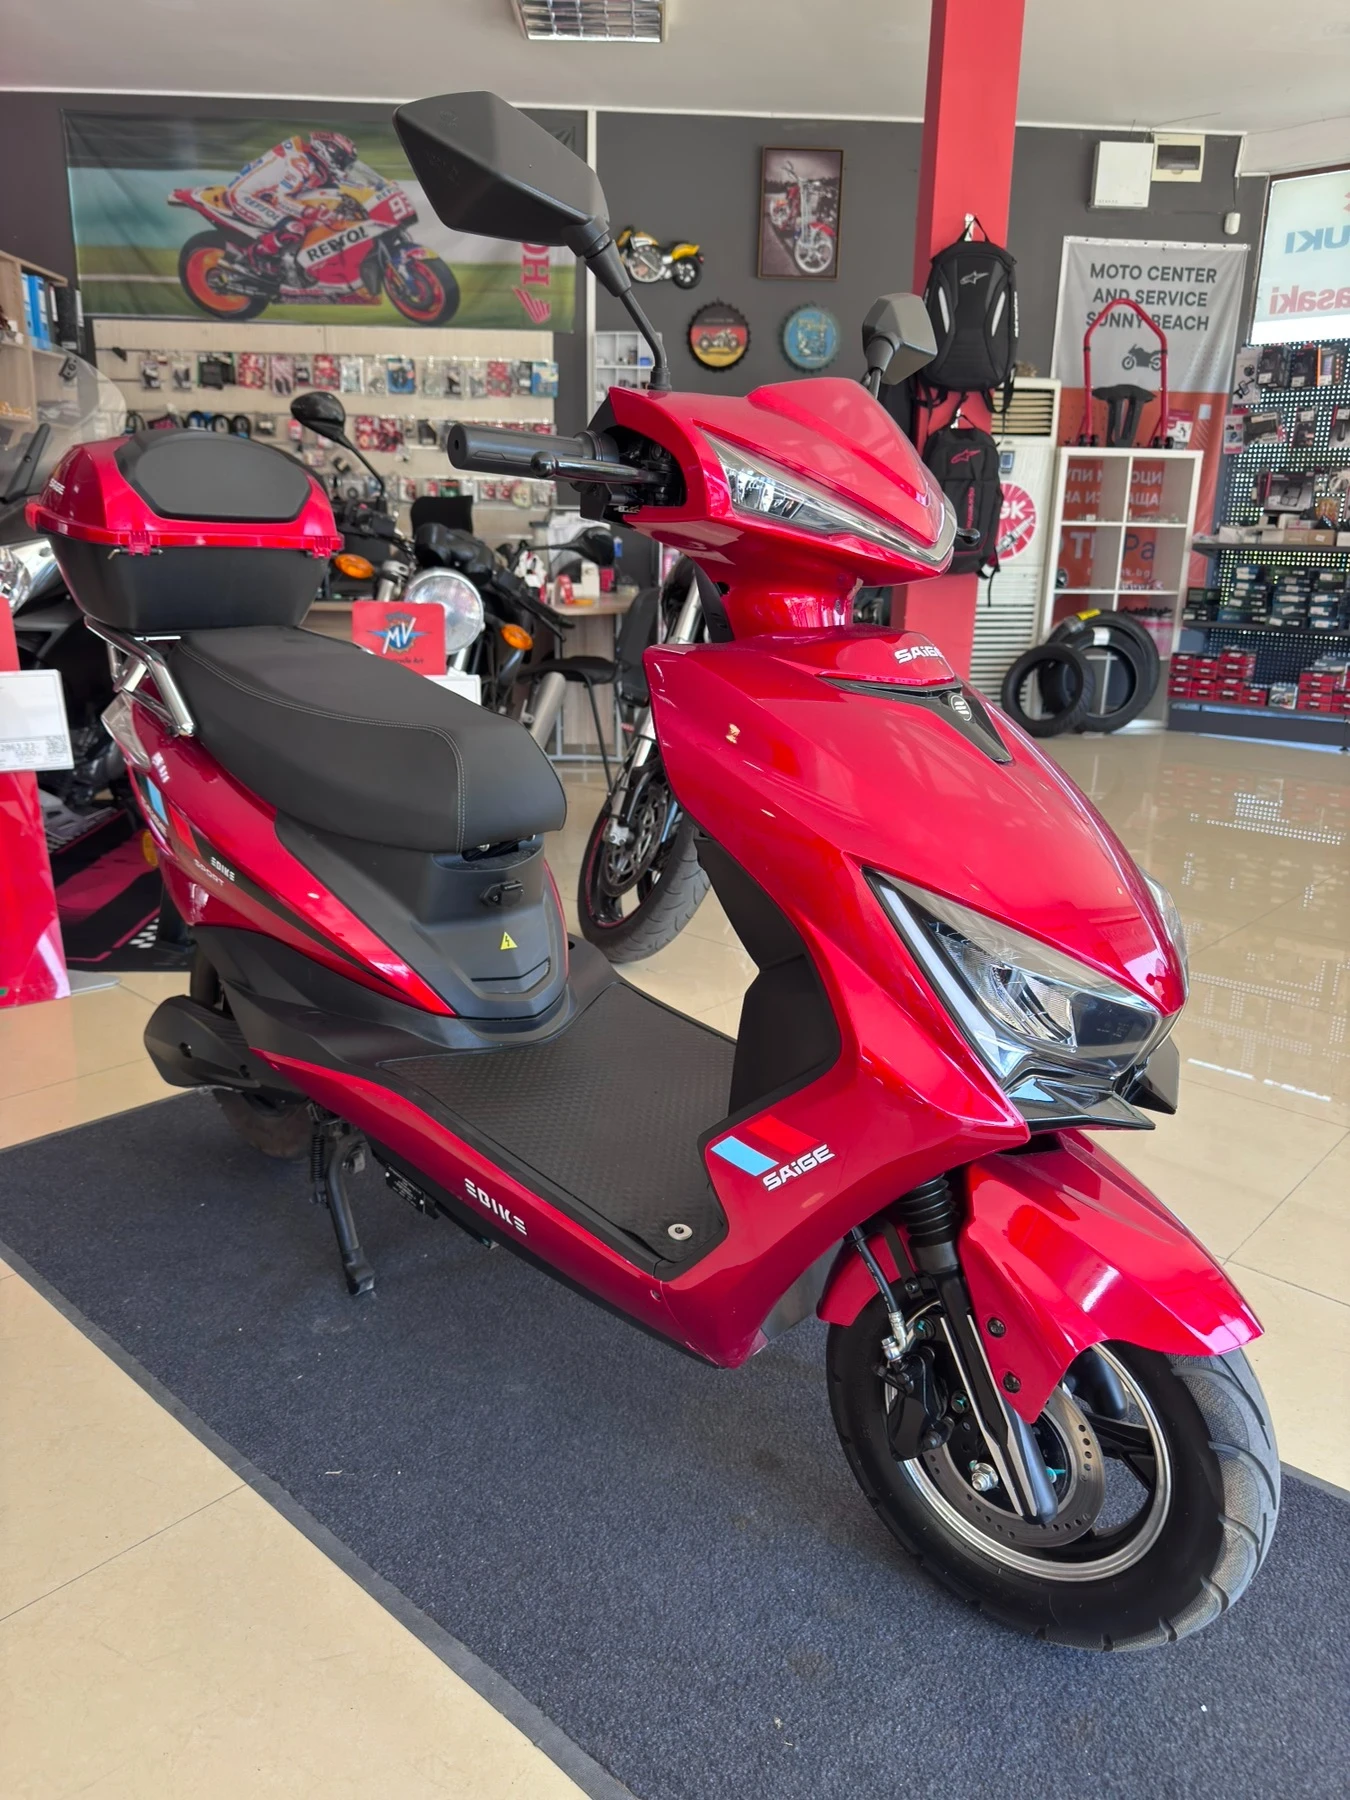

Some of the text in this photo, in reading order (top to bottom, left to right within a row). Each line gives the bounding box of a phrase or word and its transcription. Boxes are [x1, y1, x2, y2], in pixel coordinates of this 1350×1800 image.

[1090, 263, 1217, 283] MOTO CENTER
[1092, 288, 1208, 307] AND SERVICE
[1151, 314, 1209, 331] BEACH
[383, 616, 416, 655] MV
[211, 856, 236, 882] EBIKE
[464, 1177, 528, 1236] EBIKE
